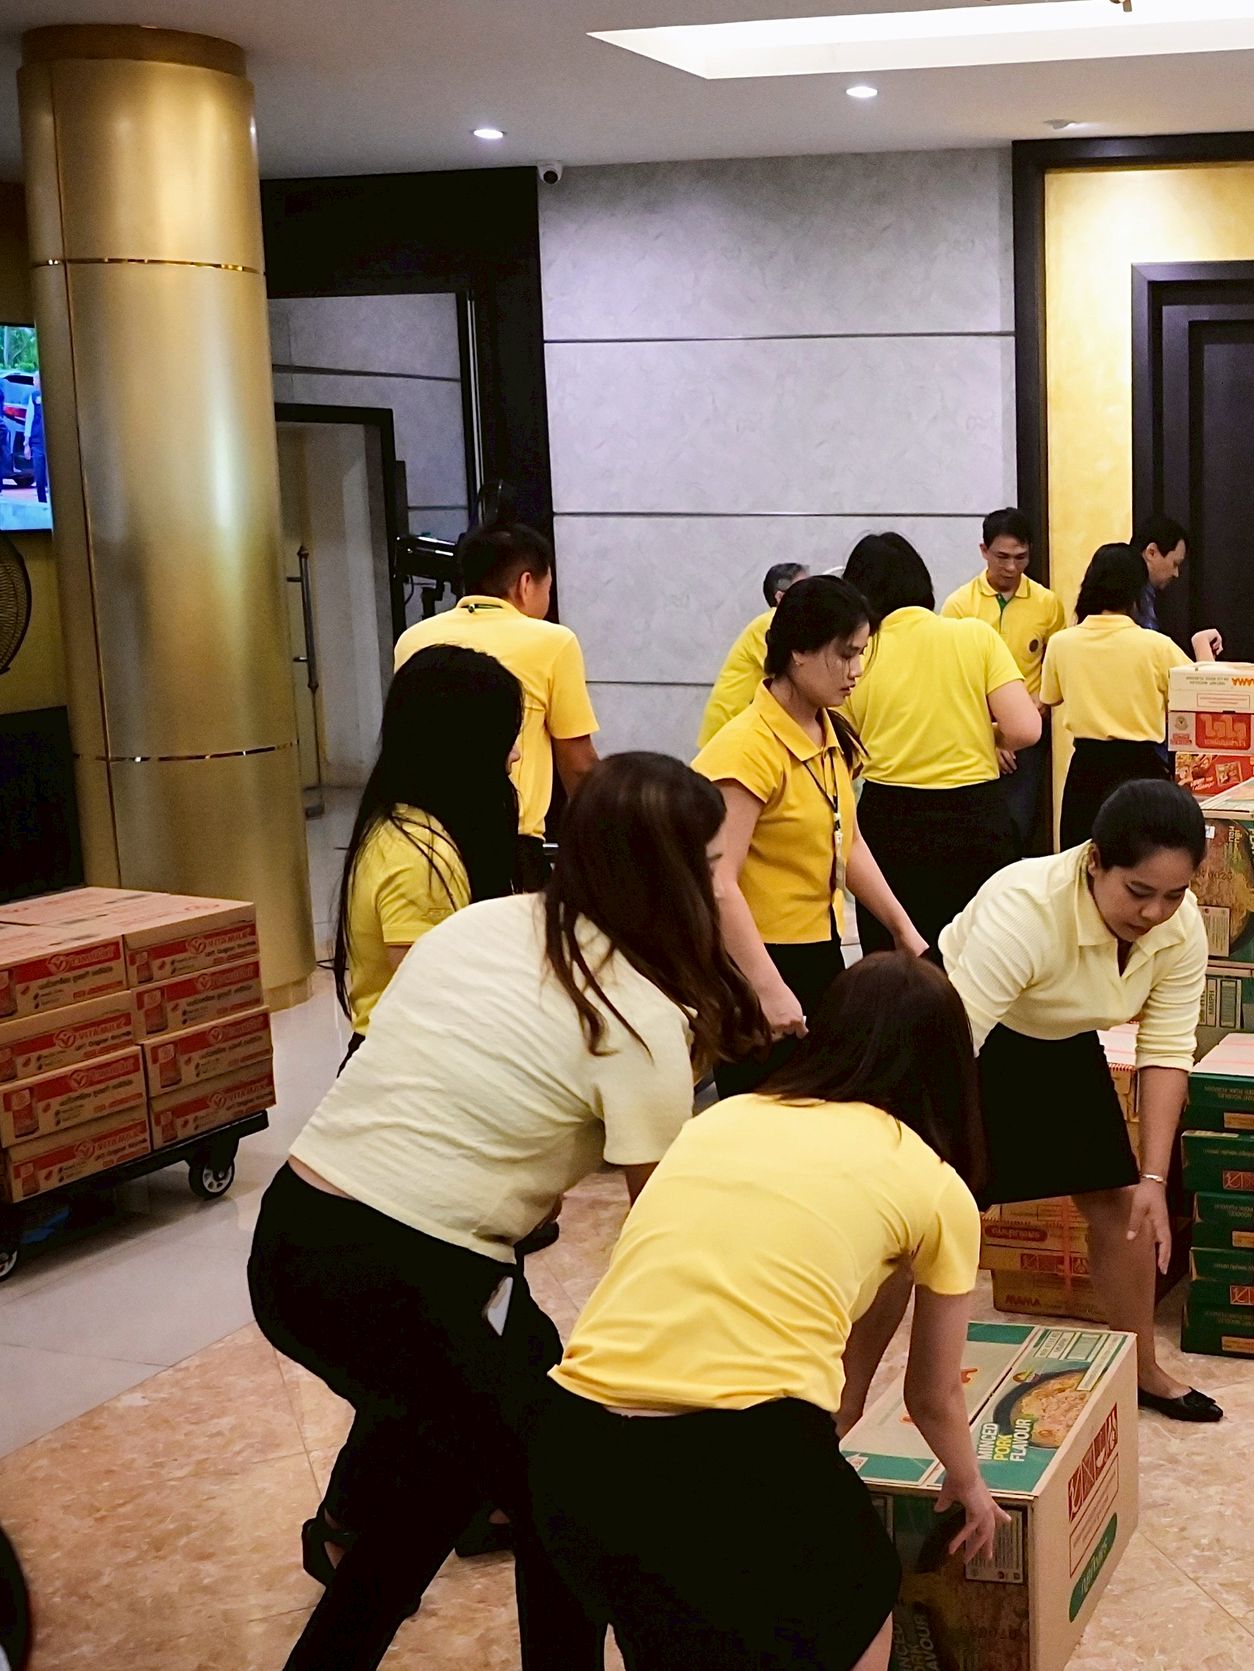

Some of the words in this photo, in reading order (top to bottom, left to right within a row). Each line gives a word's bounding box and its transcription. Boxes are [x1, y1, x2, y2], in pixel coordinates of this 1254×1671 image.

[977, 1422, 999, 1461] MINCED
[993, 1434, 1013, 1461] PORK
[1010, 1418, 1033, 1462] FLAVOUR
